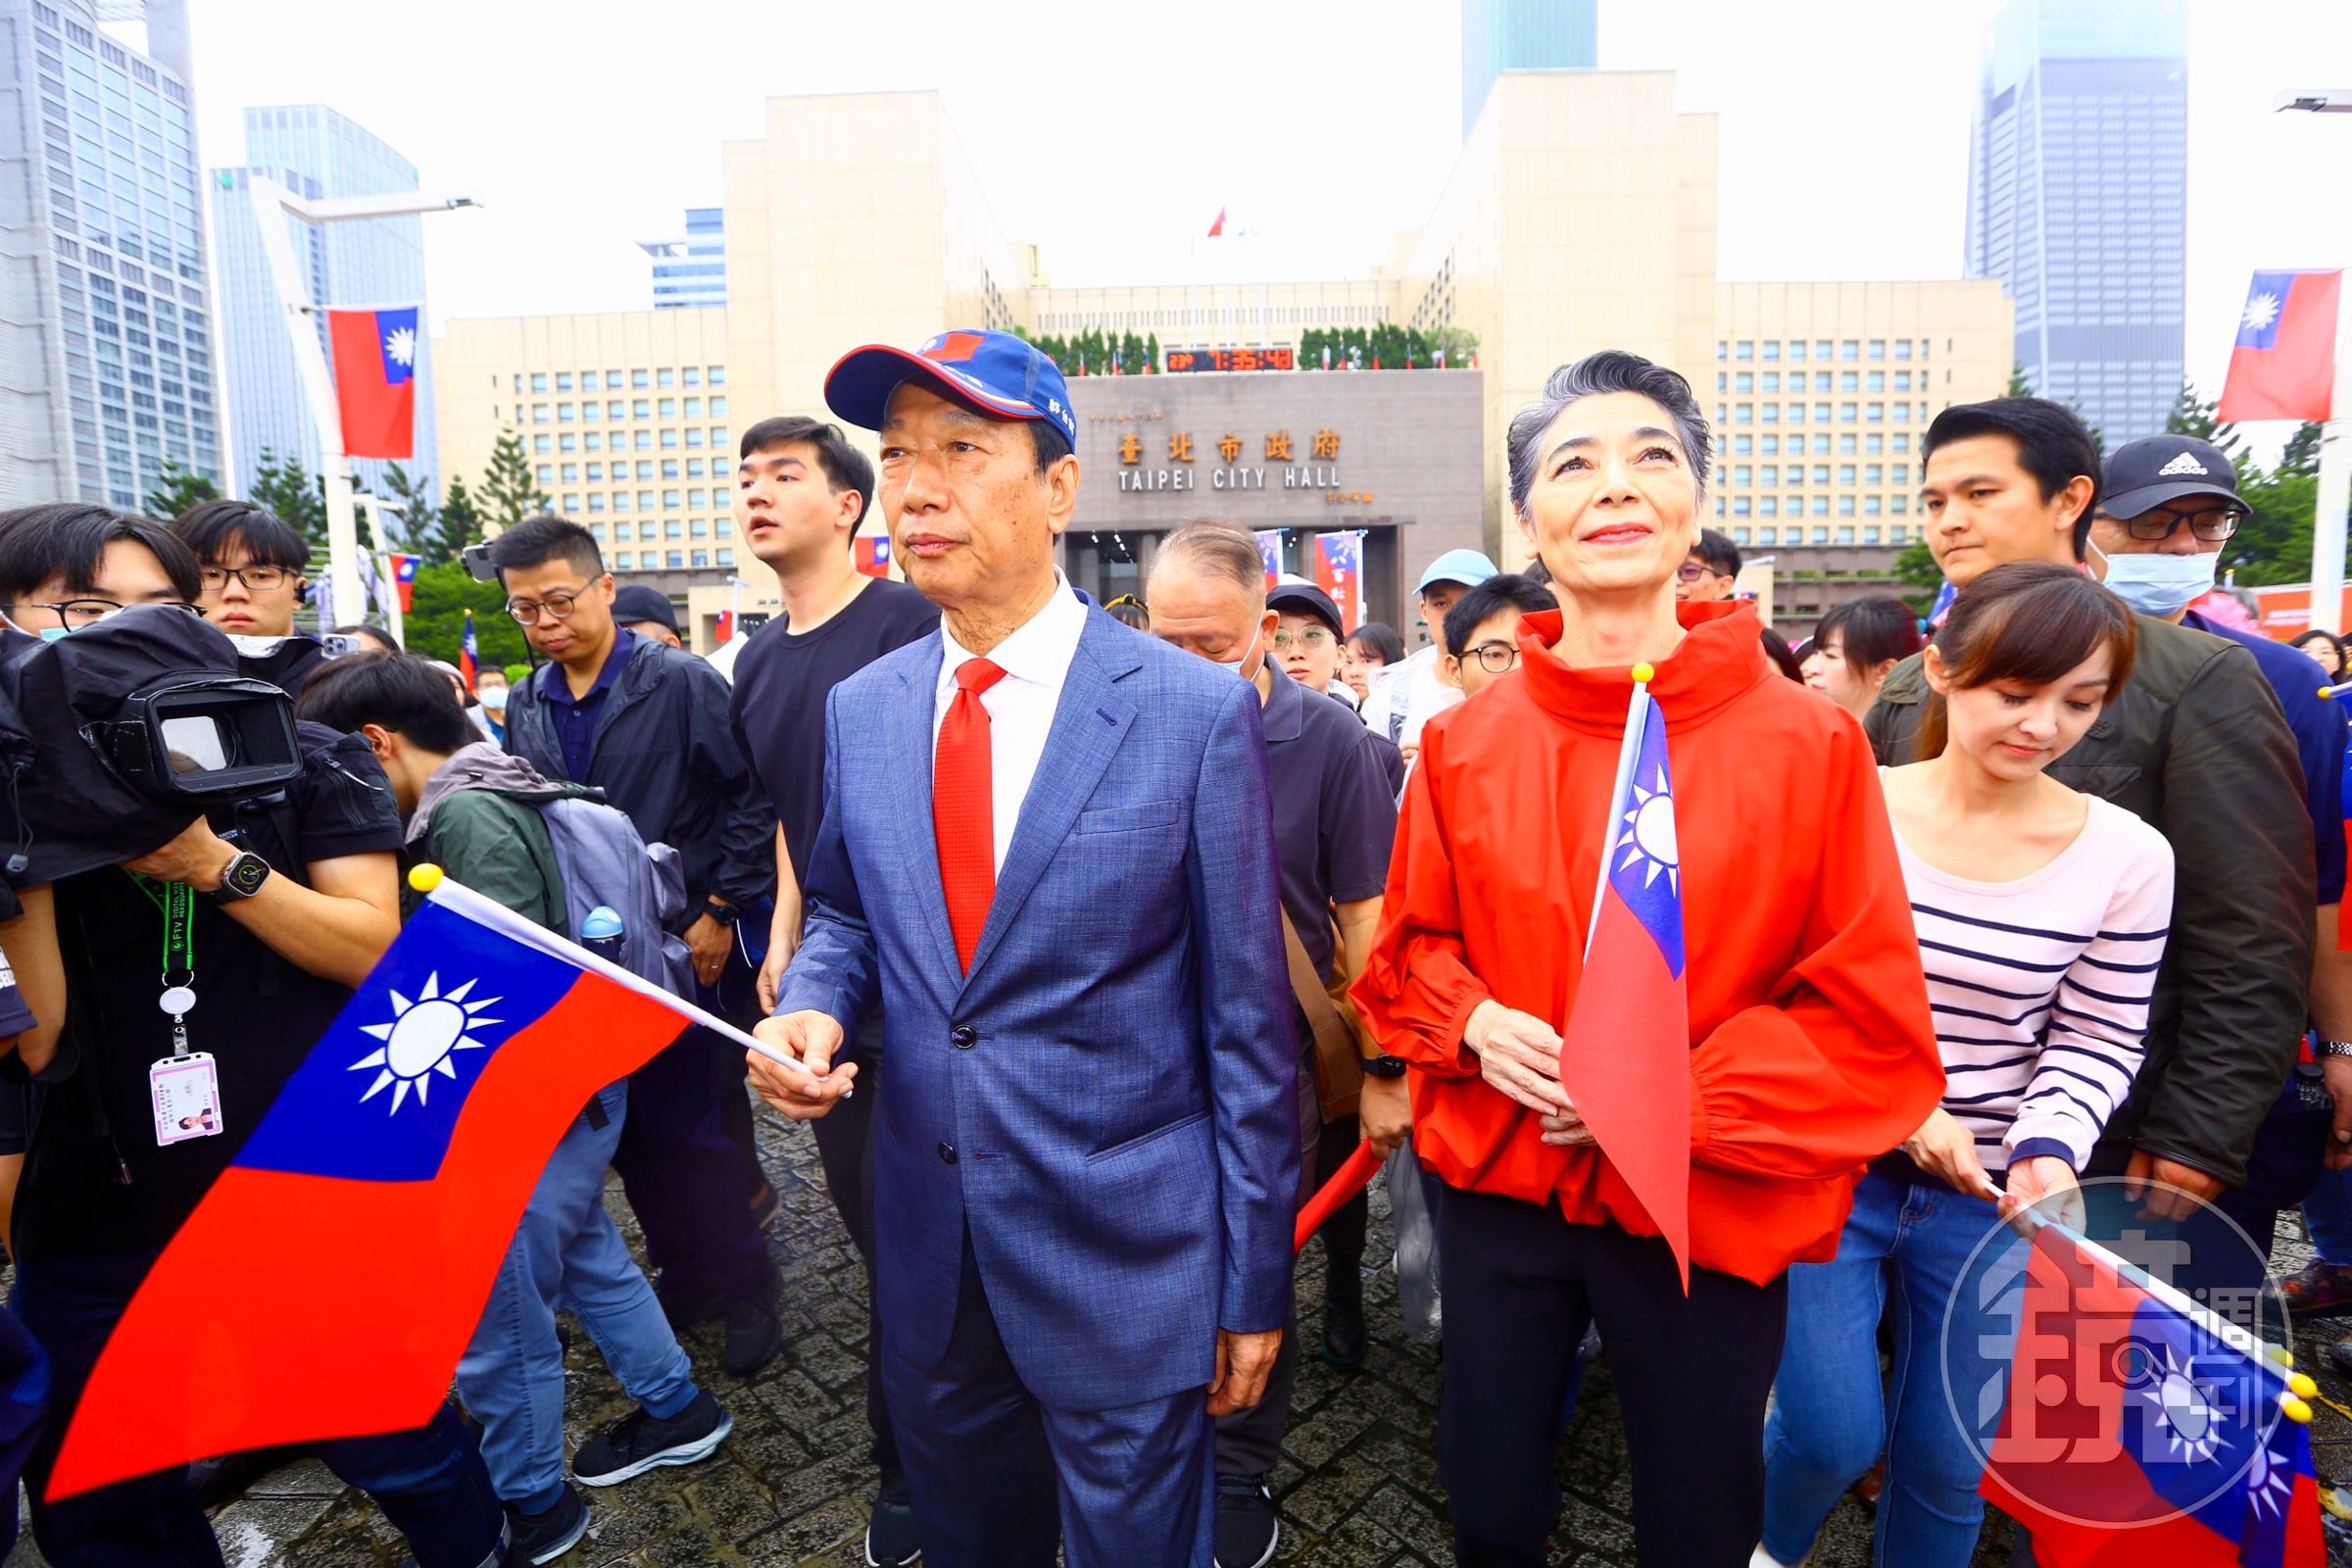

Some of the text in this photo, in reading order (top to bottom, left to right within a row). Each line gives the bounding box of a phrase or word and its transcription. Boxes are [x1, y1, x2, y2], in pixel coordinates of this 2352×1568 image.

[1117, 428, 1341, 466] 臺北市政府
[1118, 466, 1341, 490] TAIPEI CITY HALL
[2158, 465, 2209, 476] adidas
[172, 921, 183, 940] FTV
